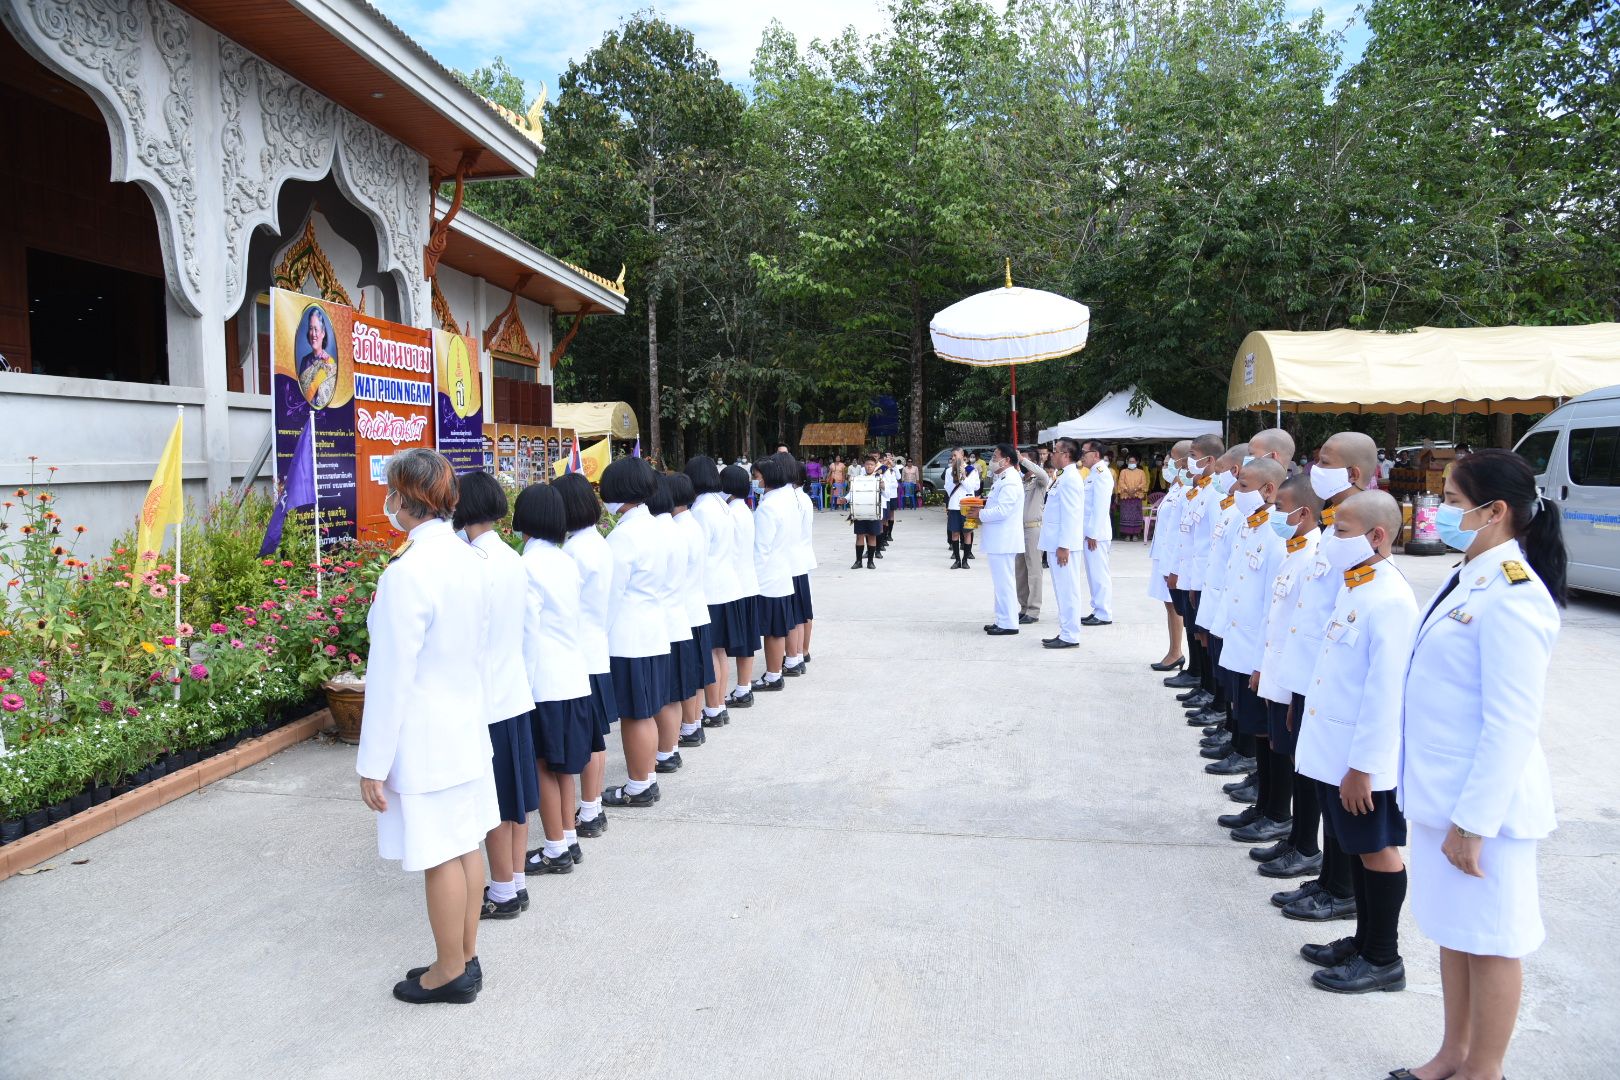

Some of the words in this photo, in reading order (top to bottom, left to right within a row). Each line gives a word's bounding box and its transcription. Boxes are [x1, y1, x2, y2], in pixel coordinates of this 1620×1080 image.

[352, 321, 431, 373] วัดโพนงาม
[354, 374, 377, 399] WAT
[377, 379, 404, 402] PHON
[404, 381, 431, 404] NGAM
[357, 408, 428, 445] ยินดีต้อนรับ
